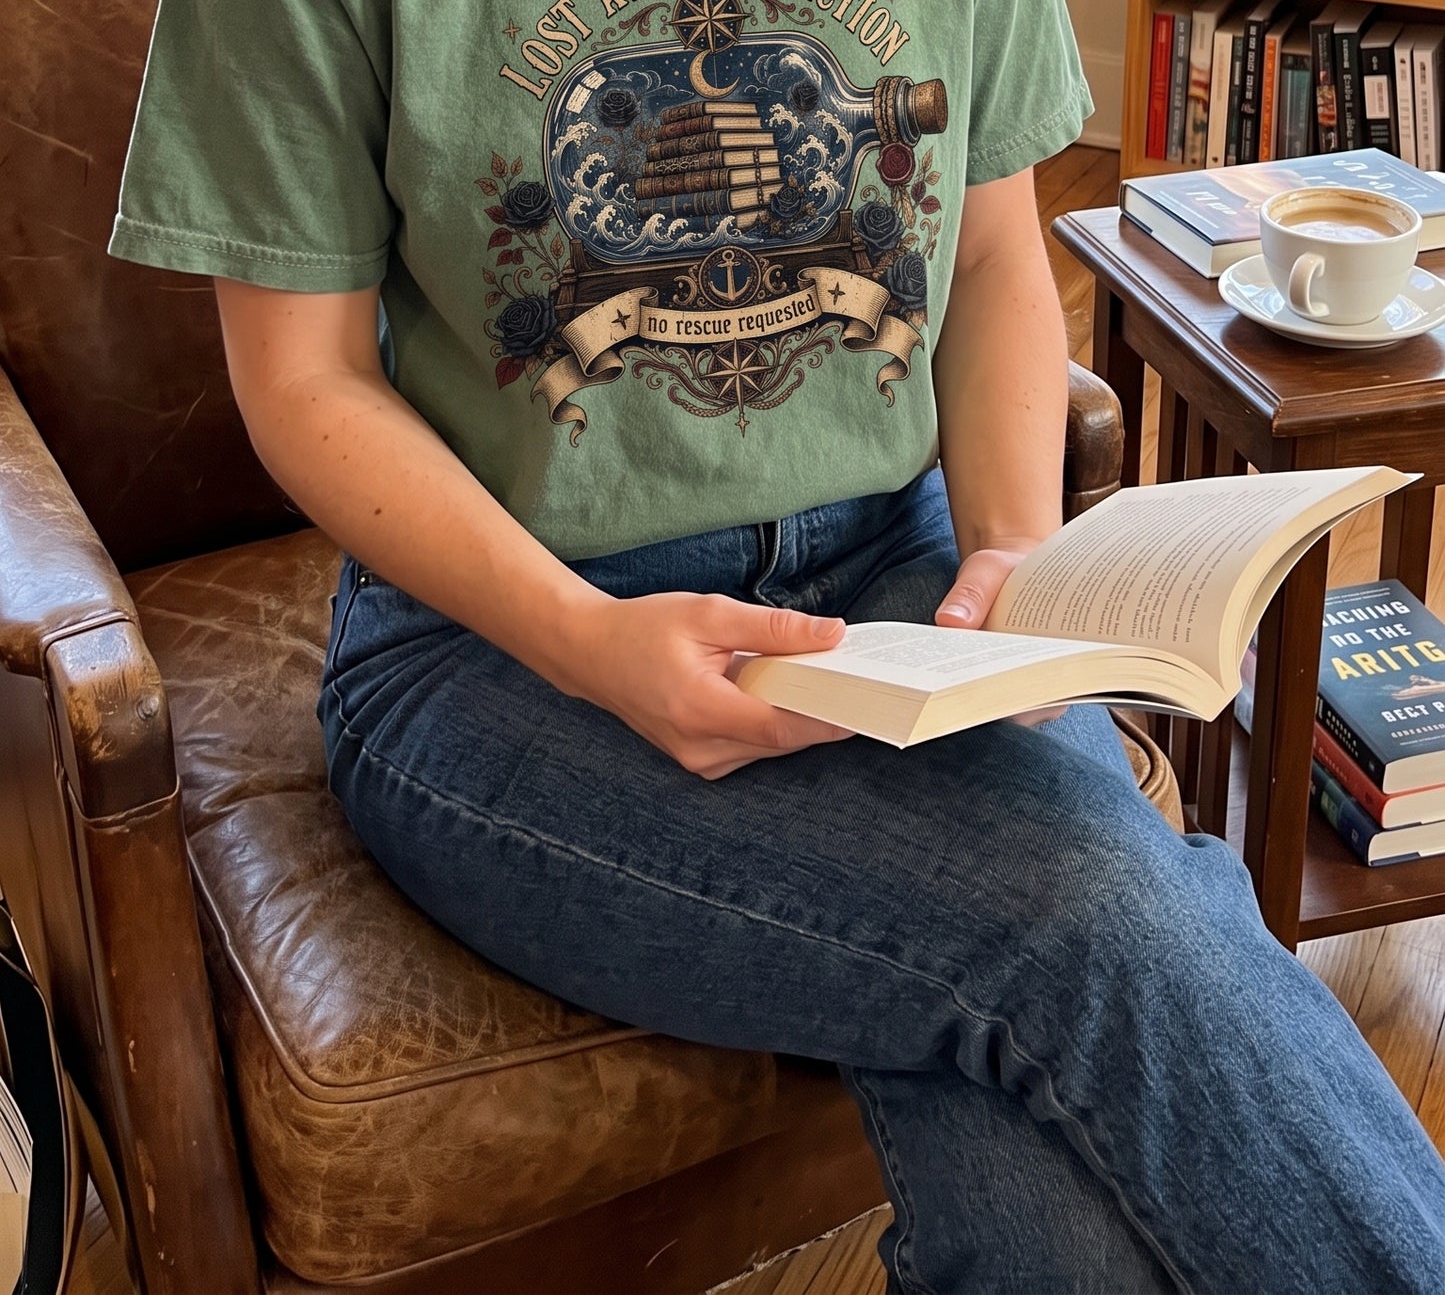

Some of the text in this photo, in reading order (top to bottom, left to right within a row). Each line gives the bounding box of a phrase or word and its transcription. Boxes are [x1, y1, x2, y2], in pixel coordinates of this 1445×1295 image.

[647, 293, 816, 336] no rescue requested
[1365, 623, 1412, 641] THE
